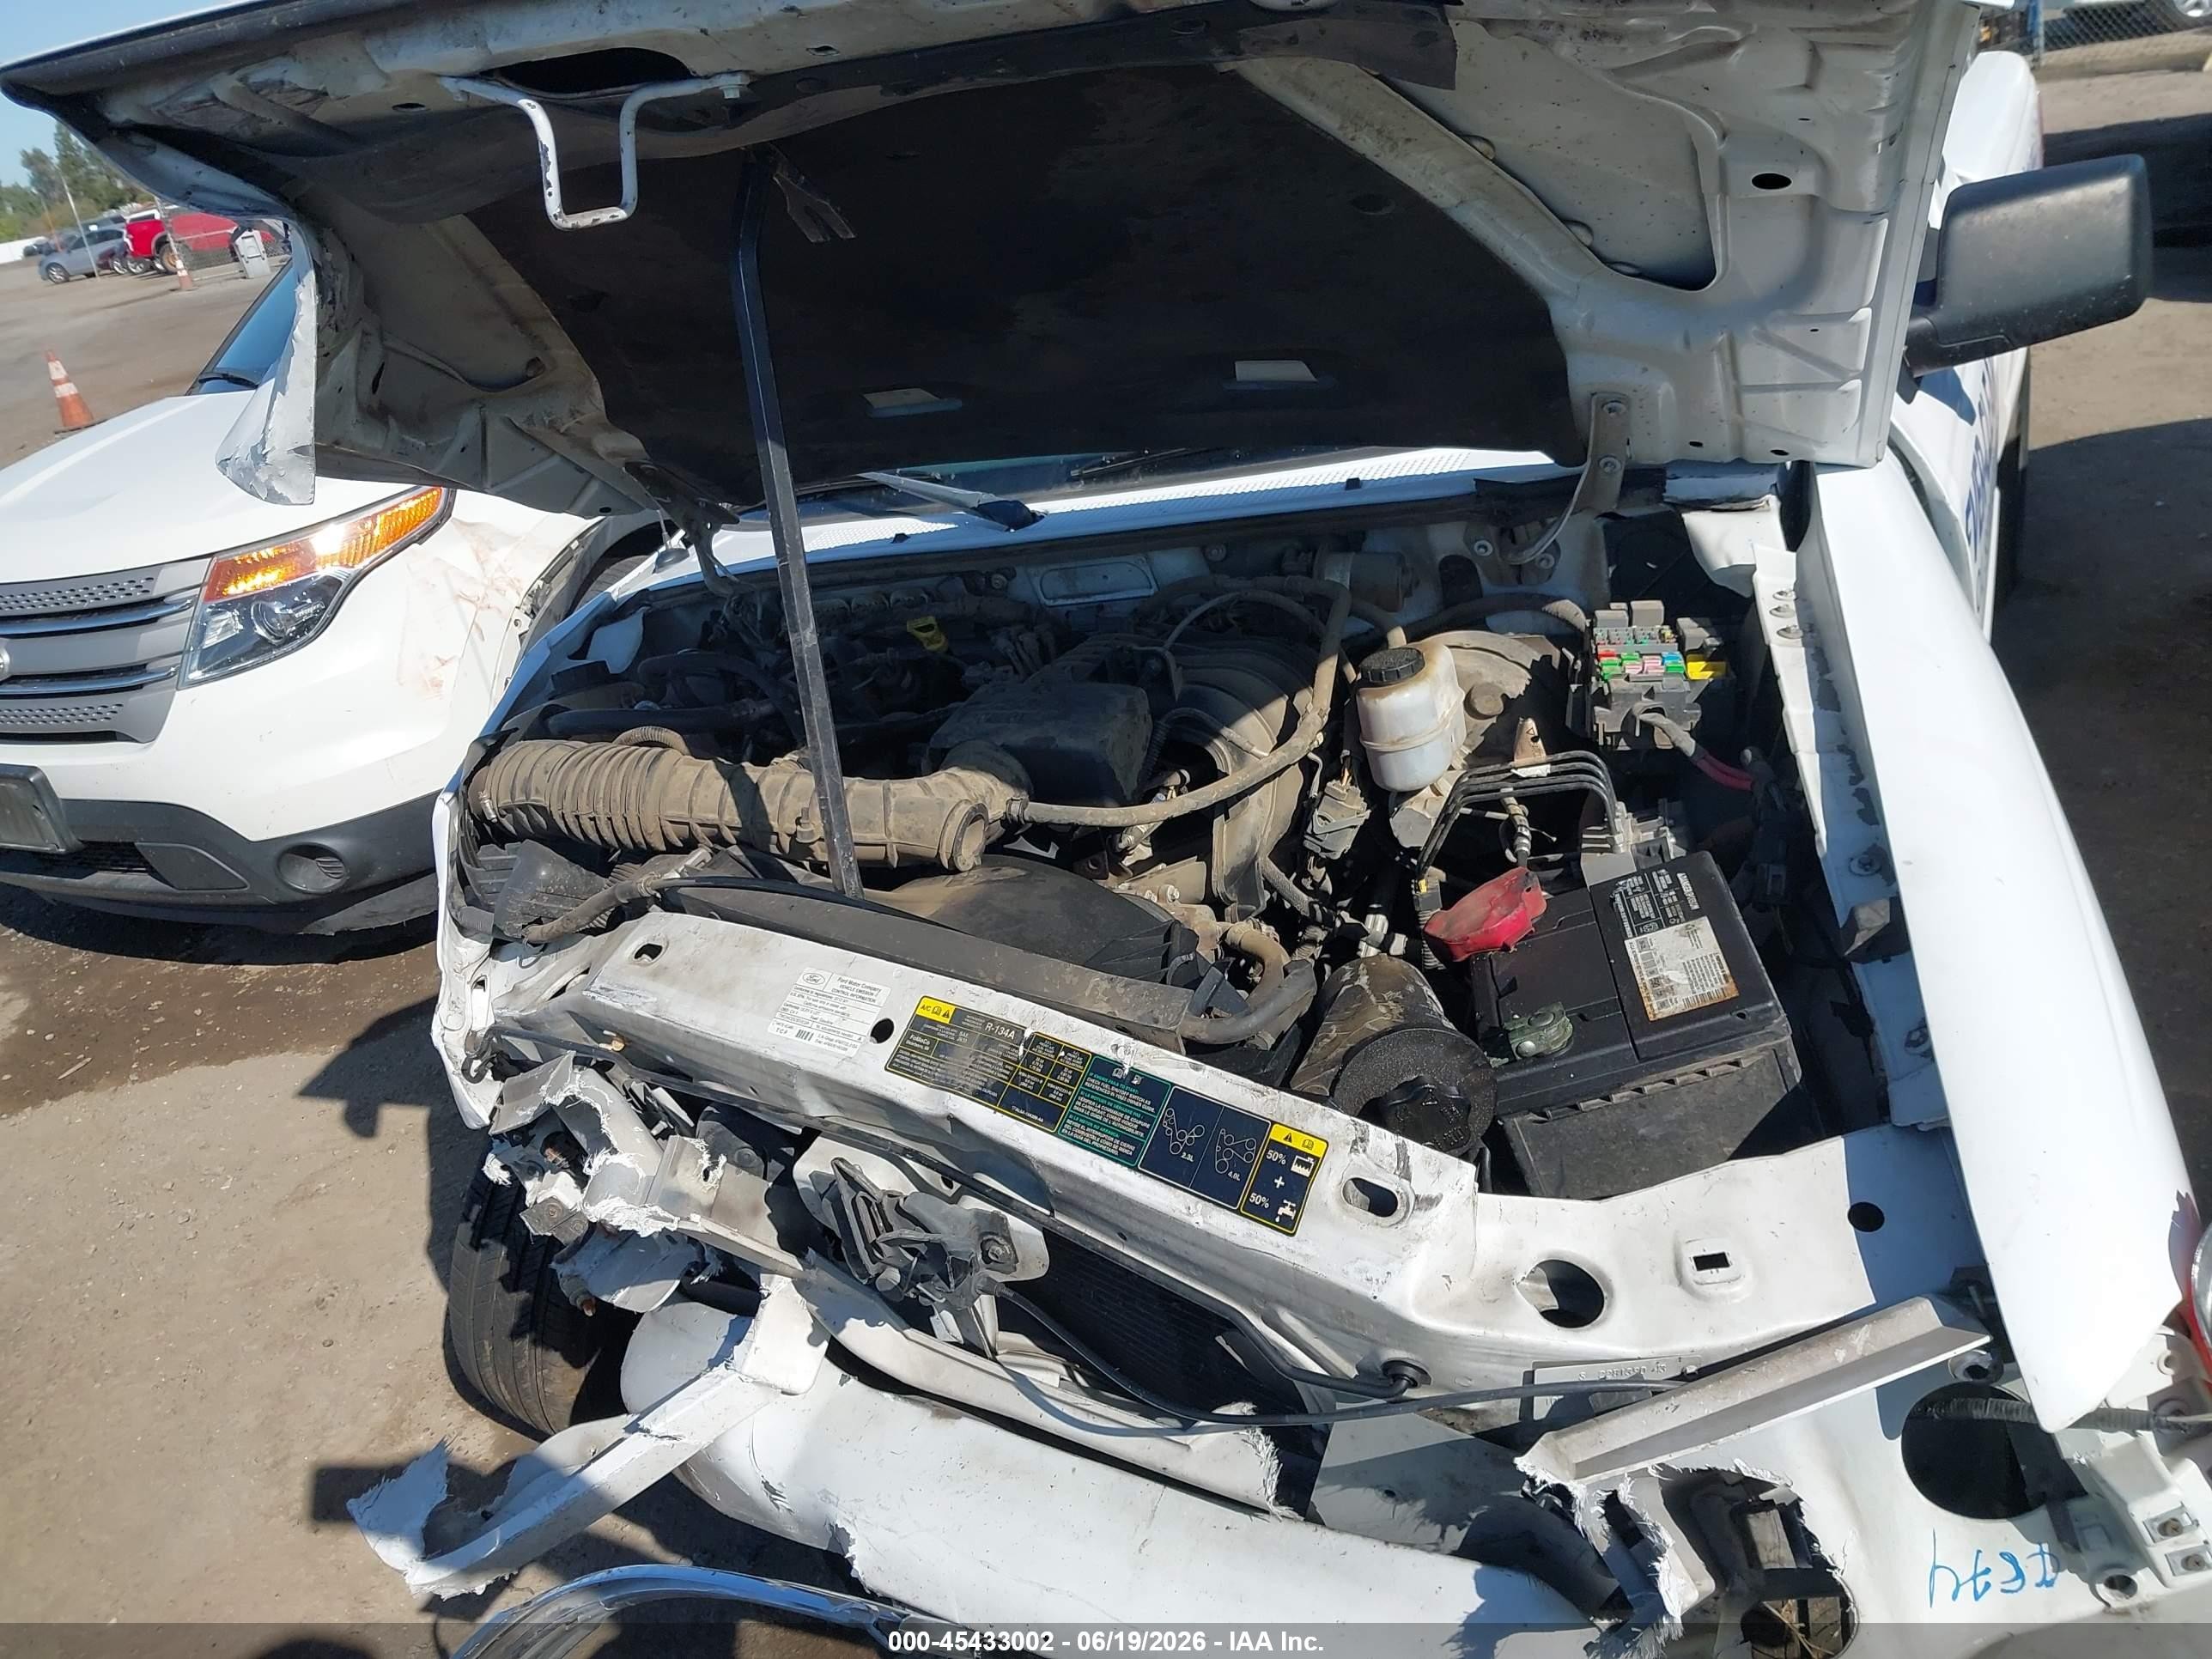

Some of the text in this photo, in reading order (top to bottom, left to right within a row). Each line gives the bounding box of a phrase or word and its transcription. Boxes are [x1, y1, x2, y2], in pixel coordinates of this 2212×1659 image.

[805, 973, 821, 983] Ford
[860, 983, 882, 994] Company
[920, 1003, 932, 1012] A/C
[983, 1022, 1017, 1040] R-134A
[908, 1033, 931, 1046] FoMoCo
[1181, 1152, 1194, 1163] 2.3L
[1266, 1149, 1286, 1165] 50%
[1249, 1192, 1271, 1209] 50%
